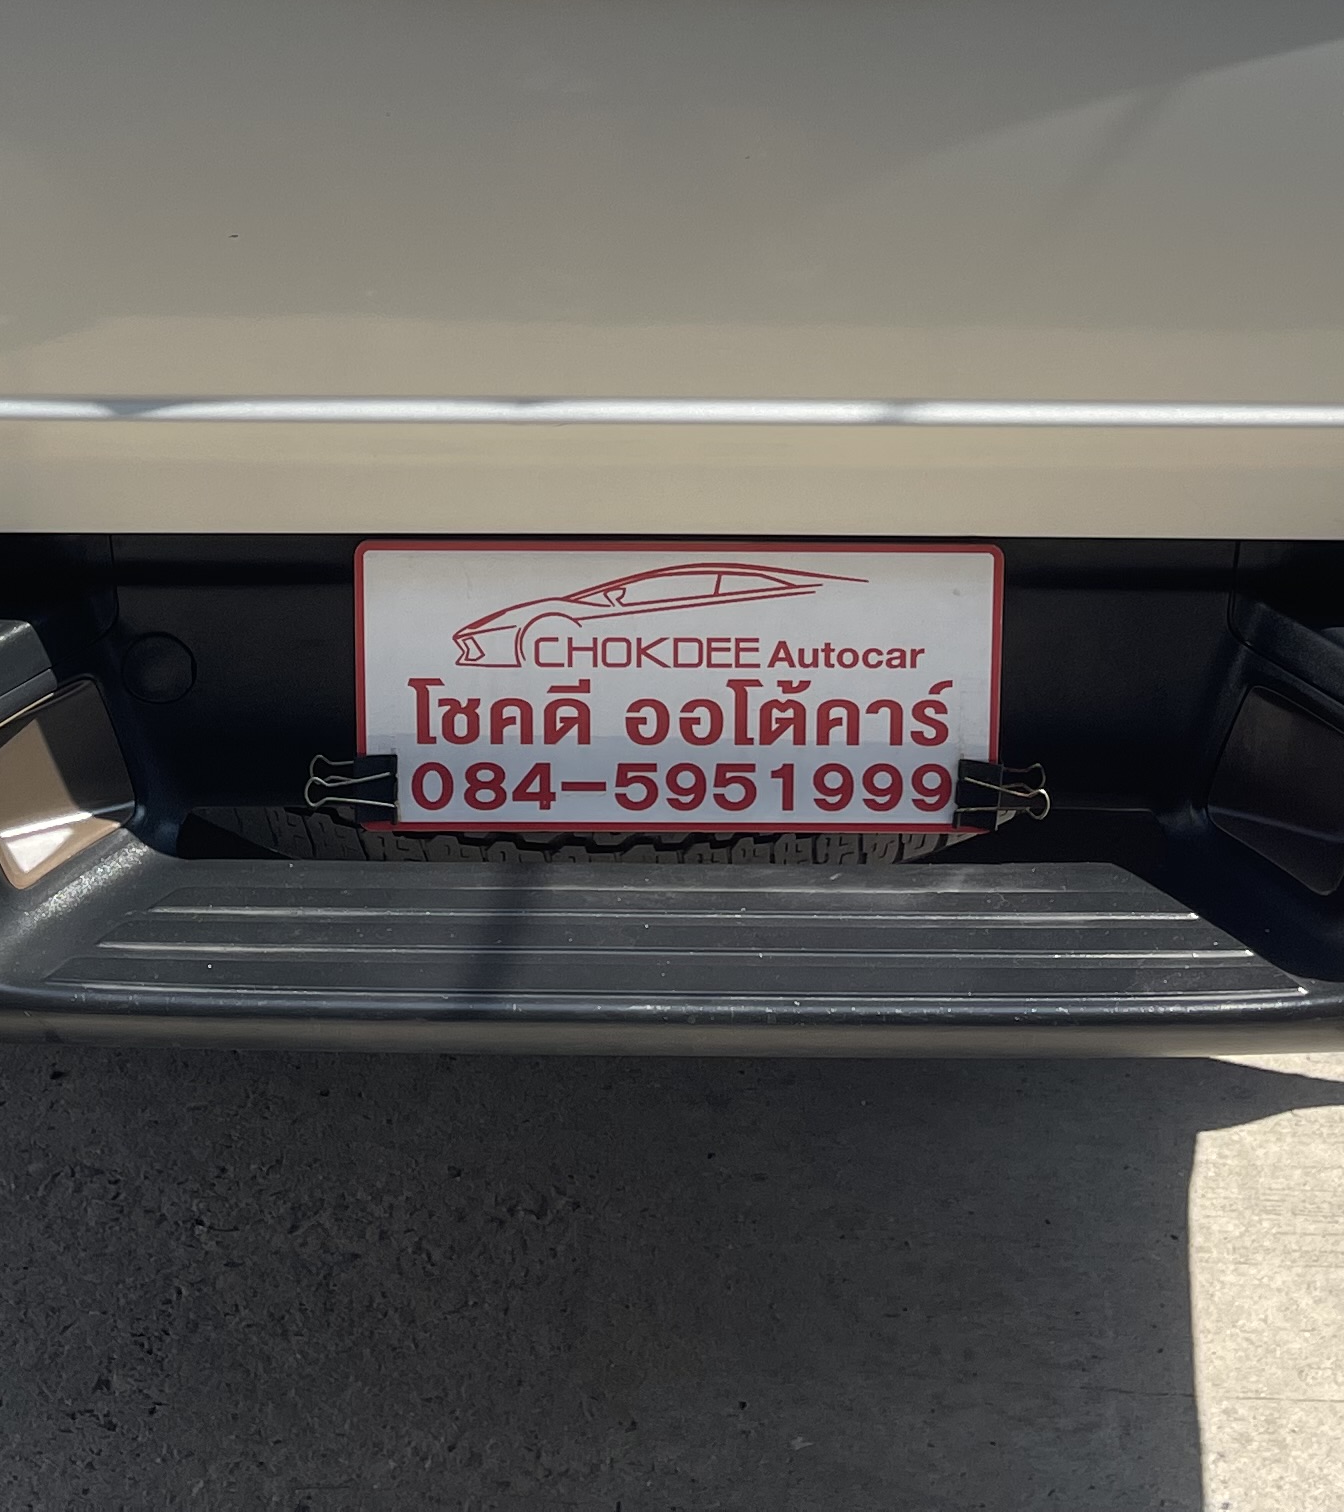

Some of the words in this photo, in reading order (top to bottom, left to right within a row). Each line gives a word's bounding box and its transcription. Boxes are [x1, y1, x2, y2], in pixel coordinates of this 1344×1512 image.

[534, 636, 761, 669] CHOKDEE
[768, 640, 925, 669] Autocar
[409, 677, 591, 745] โชคดี
[625, 678, 953, 746] ออโต้คาร์
[412, 762, 953, 811] 084-5951999
